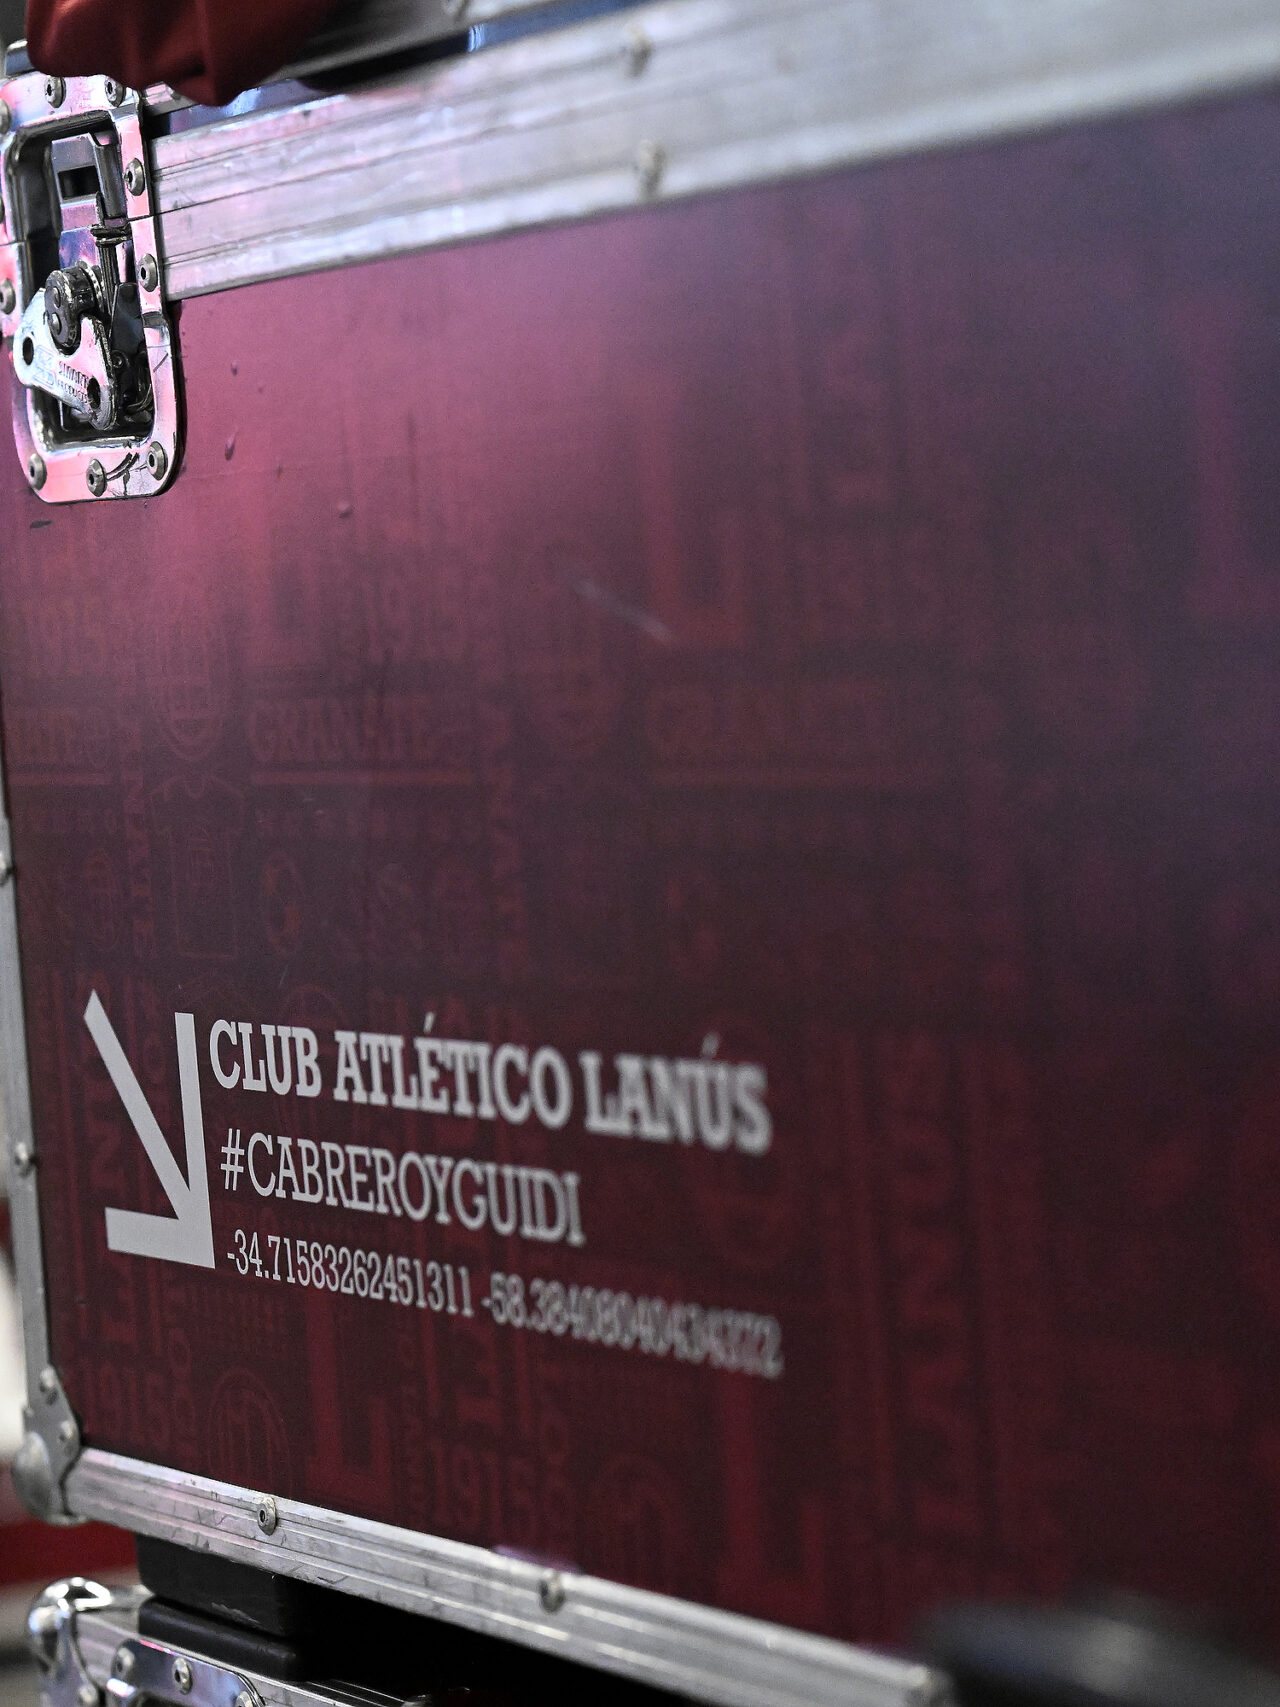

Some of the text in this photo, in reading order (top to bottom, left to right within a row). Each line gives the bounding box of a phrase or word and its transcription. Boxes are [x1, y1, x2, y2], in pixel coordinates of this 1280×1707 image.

[209, 1011, 773, 1155] CLUB ATLÉTICO LANÚS
[220, 1127, 586, 1247] #CABREROYGUIDI
[227, 1228, 475, 1318] -34.71583262451311
